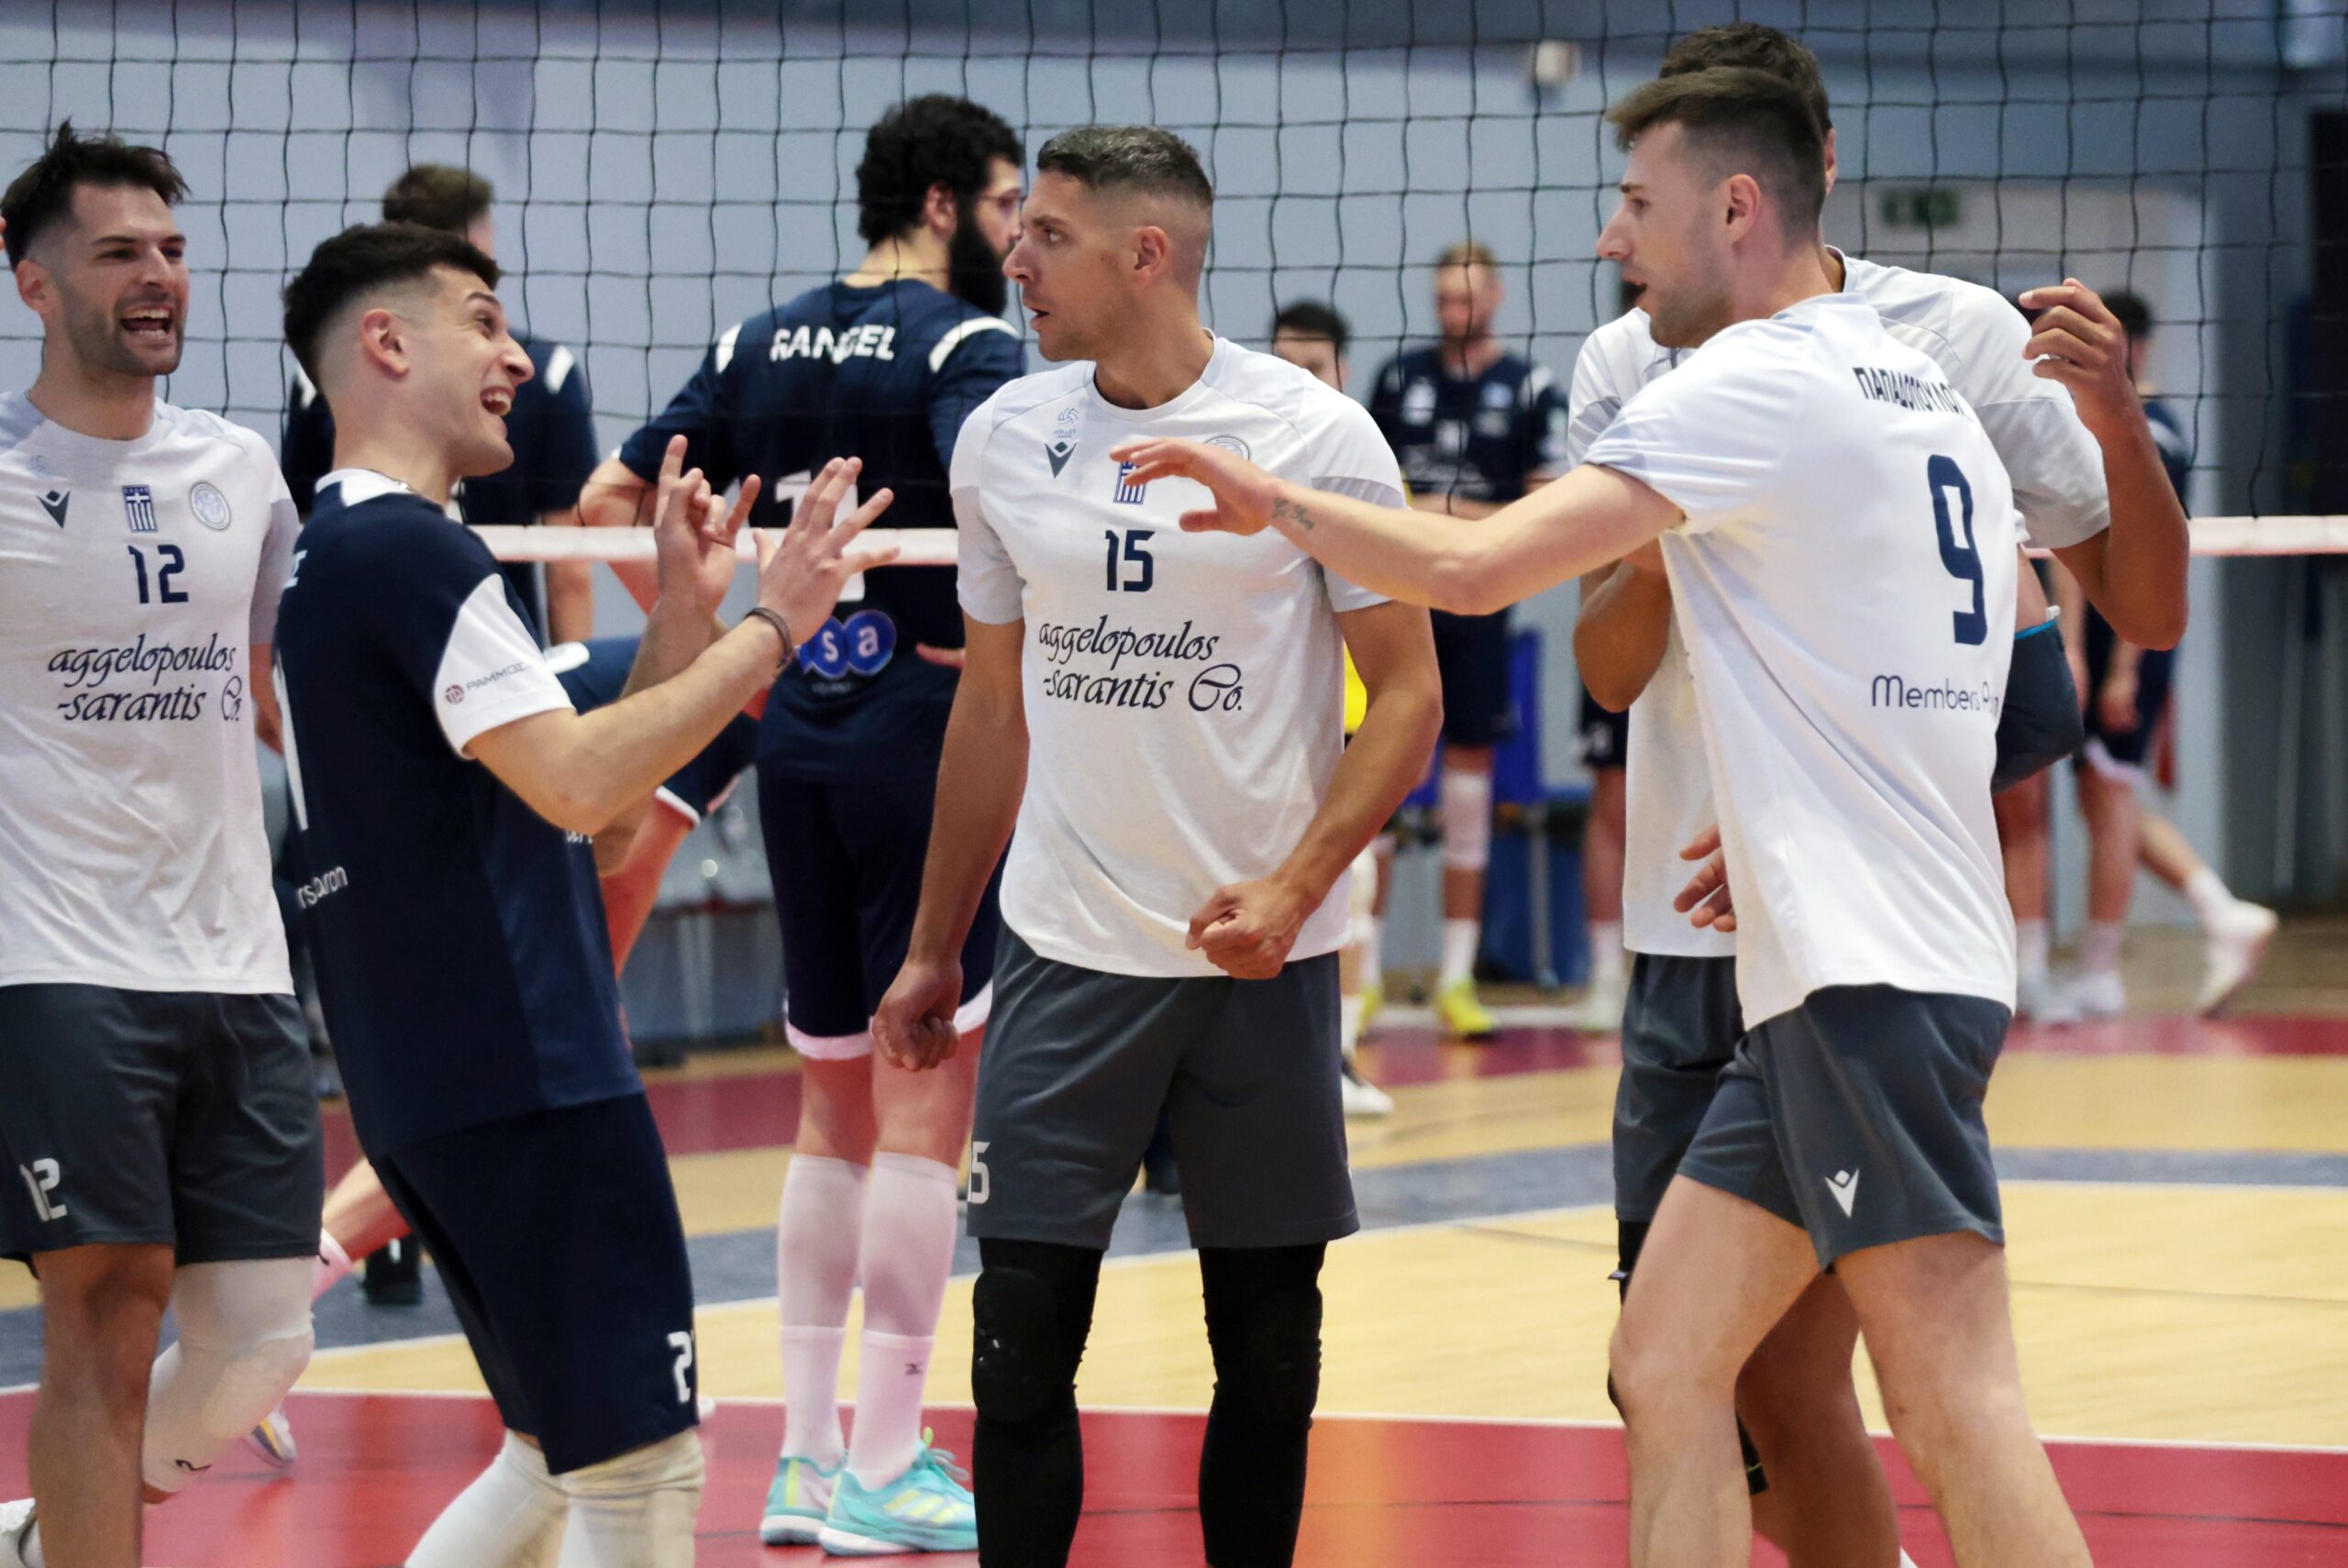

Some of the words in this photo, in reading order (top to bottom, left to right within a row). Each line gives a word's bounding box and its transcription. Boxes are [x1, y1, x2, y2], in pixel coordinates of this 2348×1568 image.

[770, 325, 895, 364] RANGEL
[127, 544, 189, 604] 12
[1104, 529, 1156, 592] 15
[1927, 454, 1988, 646] 9
[48, 633, 237, 687] aggelopoulos
[1039, 614, 1220, 670] aggelopoulos
[1872, 675, 1980, 712] Members
[19, 1157, 68, 1221] 12
[968, 1141, 991, 1204] 5
[667, 1330, 694, 1403] 2
